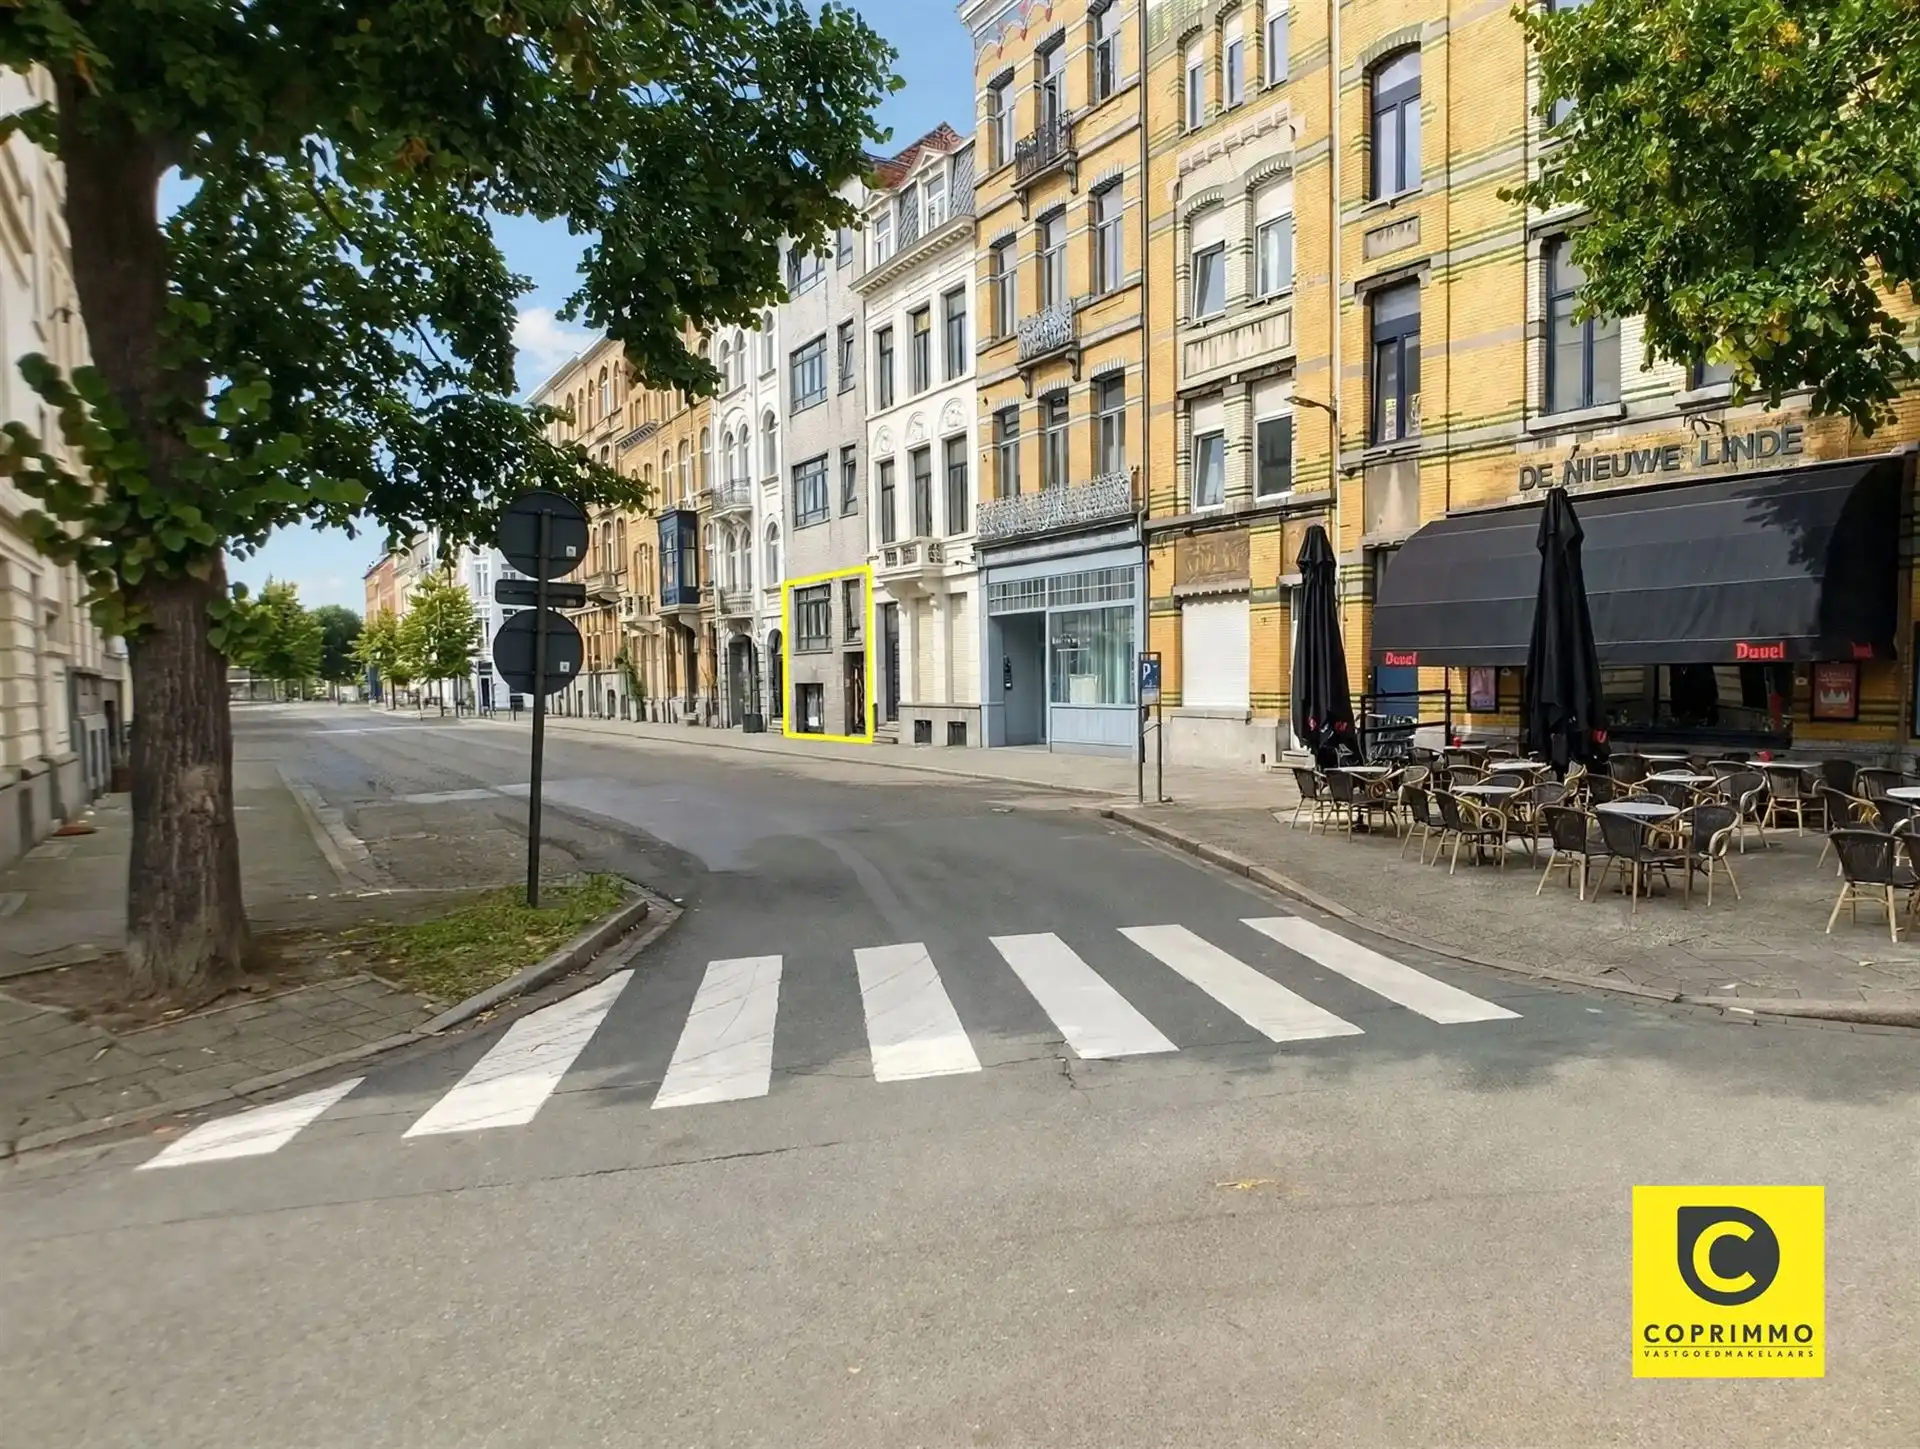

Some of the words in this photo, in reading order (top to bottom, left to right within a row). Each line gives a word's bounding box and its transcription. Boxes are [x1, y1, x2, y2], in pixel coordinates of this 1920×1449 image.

[1519, 463, 1554, 492] DE
[1563, 444, 1681, 486] NIEUWE
[1700, 424, 1804, 467] LINDE
[1142, 662, 1152, 681] P
